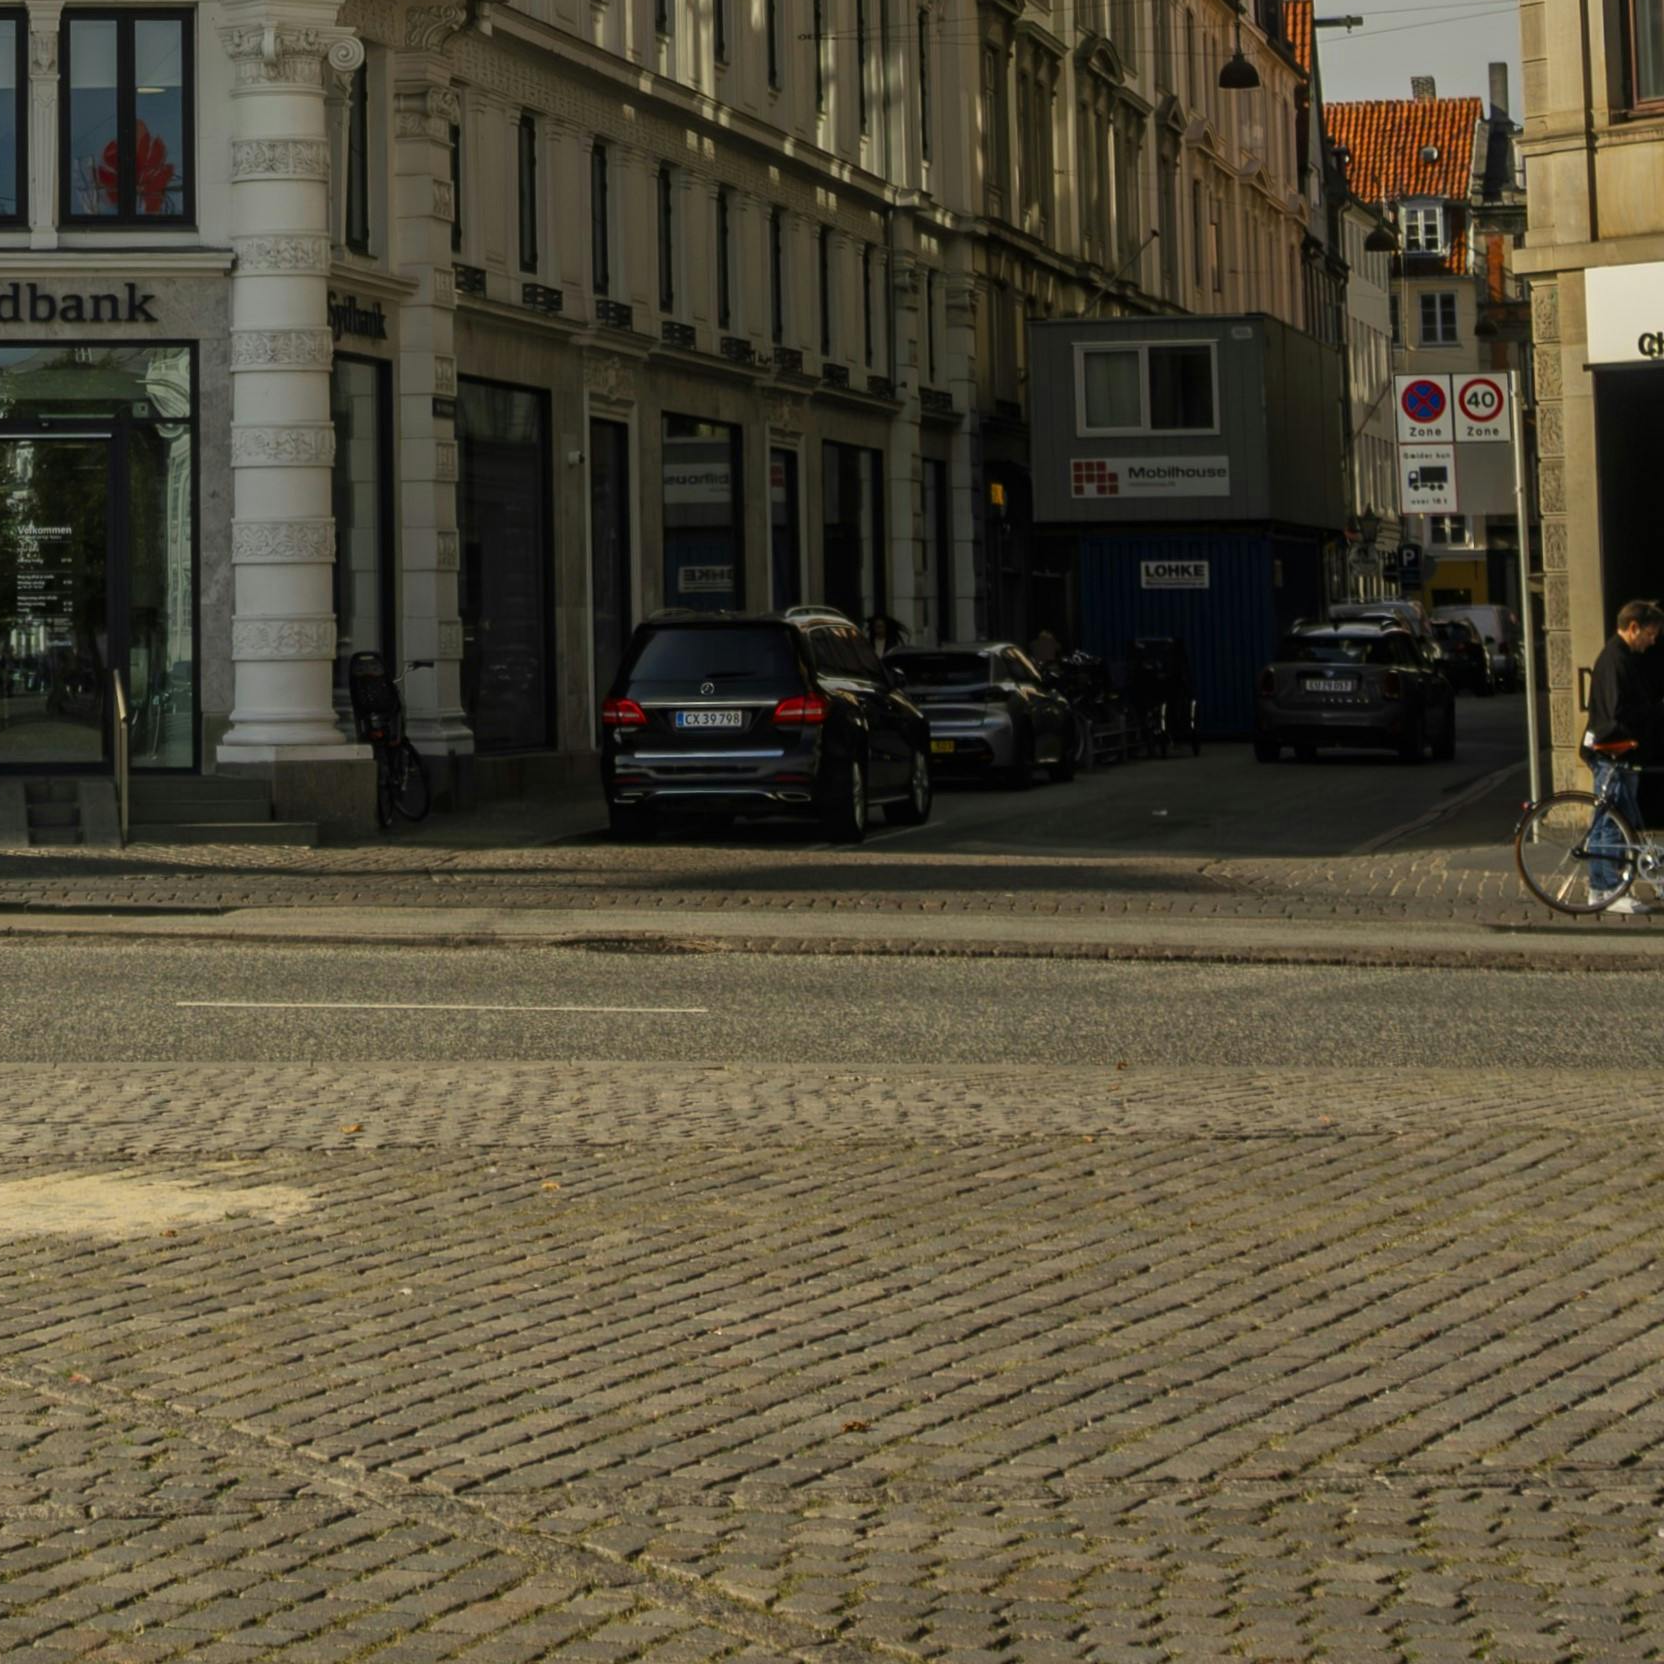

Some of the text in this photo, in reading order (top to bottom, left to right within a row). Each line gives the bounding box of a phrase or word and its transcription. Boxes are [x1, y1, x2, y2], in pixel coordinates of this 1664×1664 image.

[1467, 391, 1495, 408] 40
[1409, 427, 1442, 437] Zone
[1467, 426, 1500, 436] Zone
[1128, 466, 1226, 479] Mobilhouse
[1145, 564, 1205, 578] LOHKE
[685, 712, 740, 725] CX 39 798
